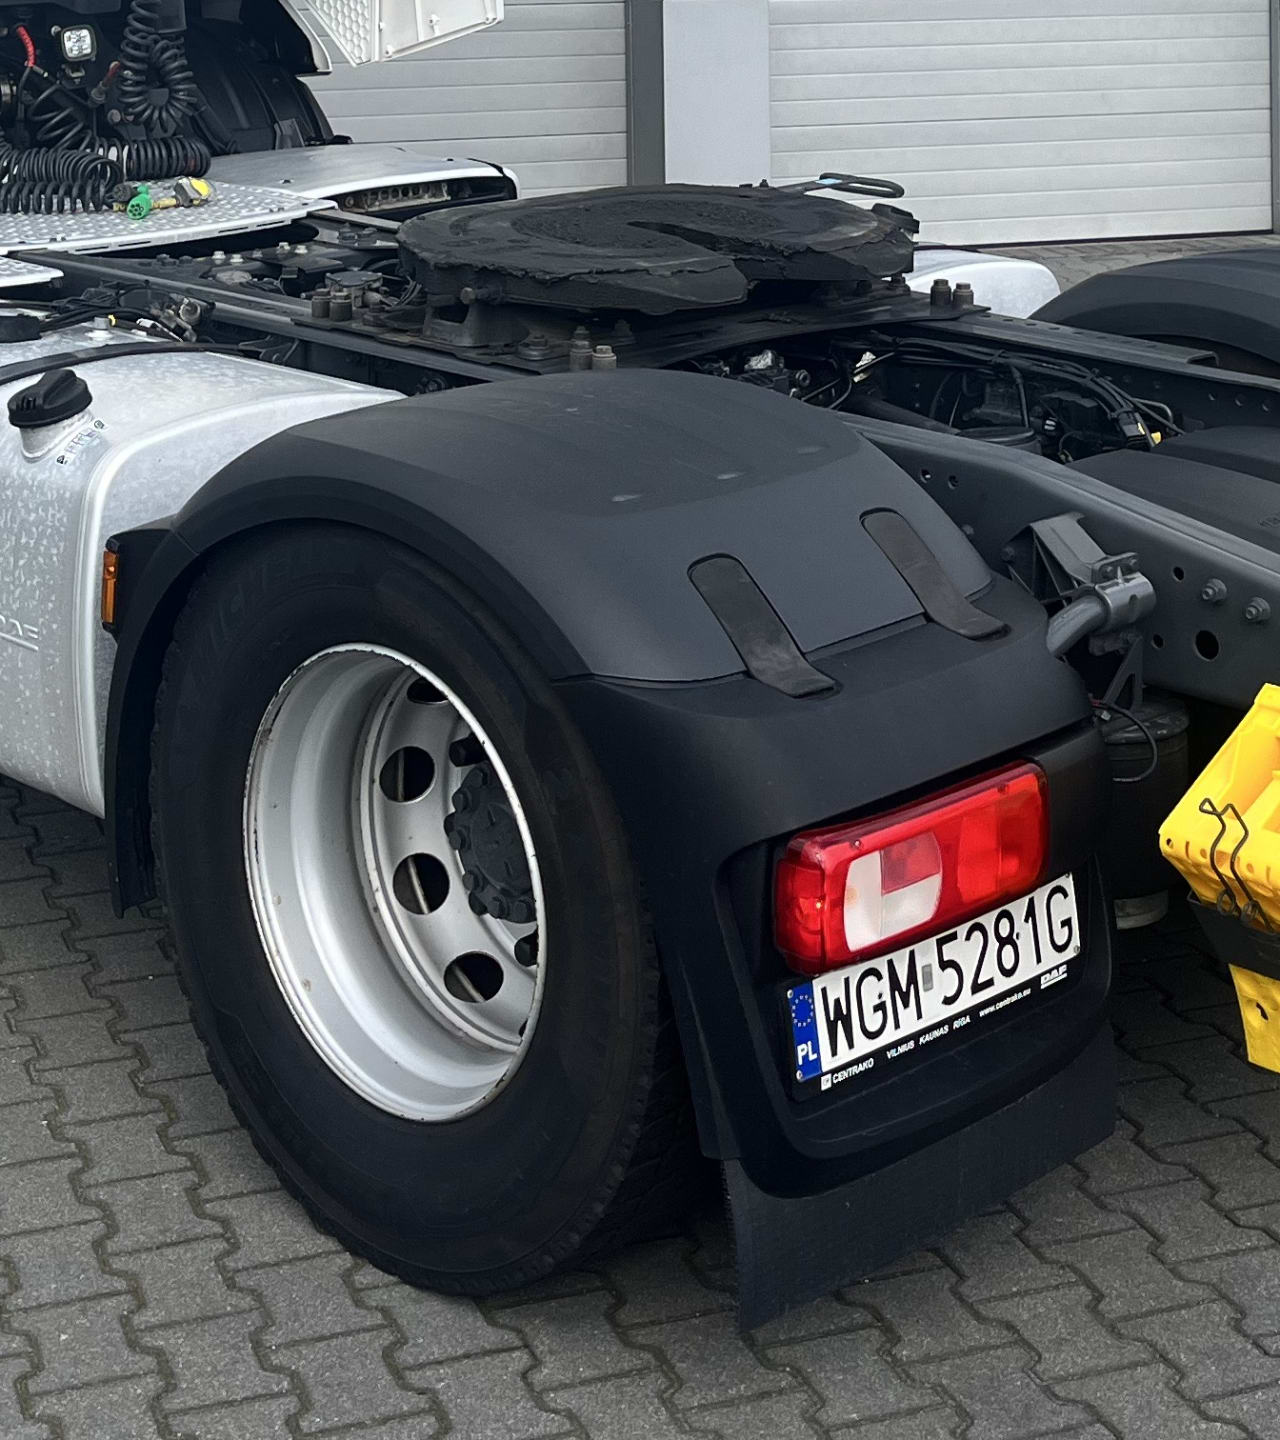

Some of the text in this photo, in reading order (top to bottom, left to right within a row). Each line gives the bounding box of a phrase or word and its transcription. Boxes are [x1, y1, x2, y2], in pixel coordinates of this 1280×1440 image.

[820, 885, 1074, 1058] WGM 5281G
[1040, 963, 1068, 985] DAF
[797, 1041, 818, 1067] PL
[832, 1057, 875, 1084] CENTRAKO
[885, 1039, 916, 1060] VILNIUS
[919, 1024, 950, 1046] KAUNAS
